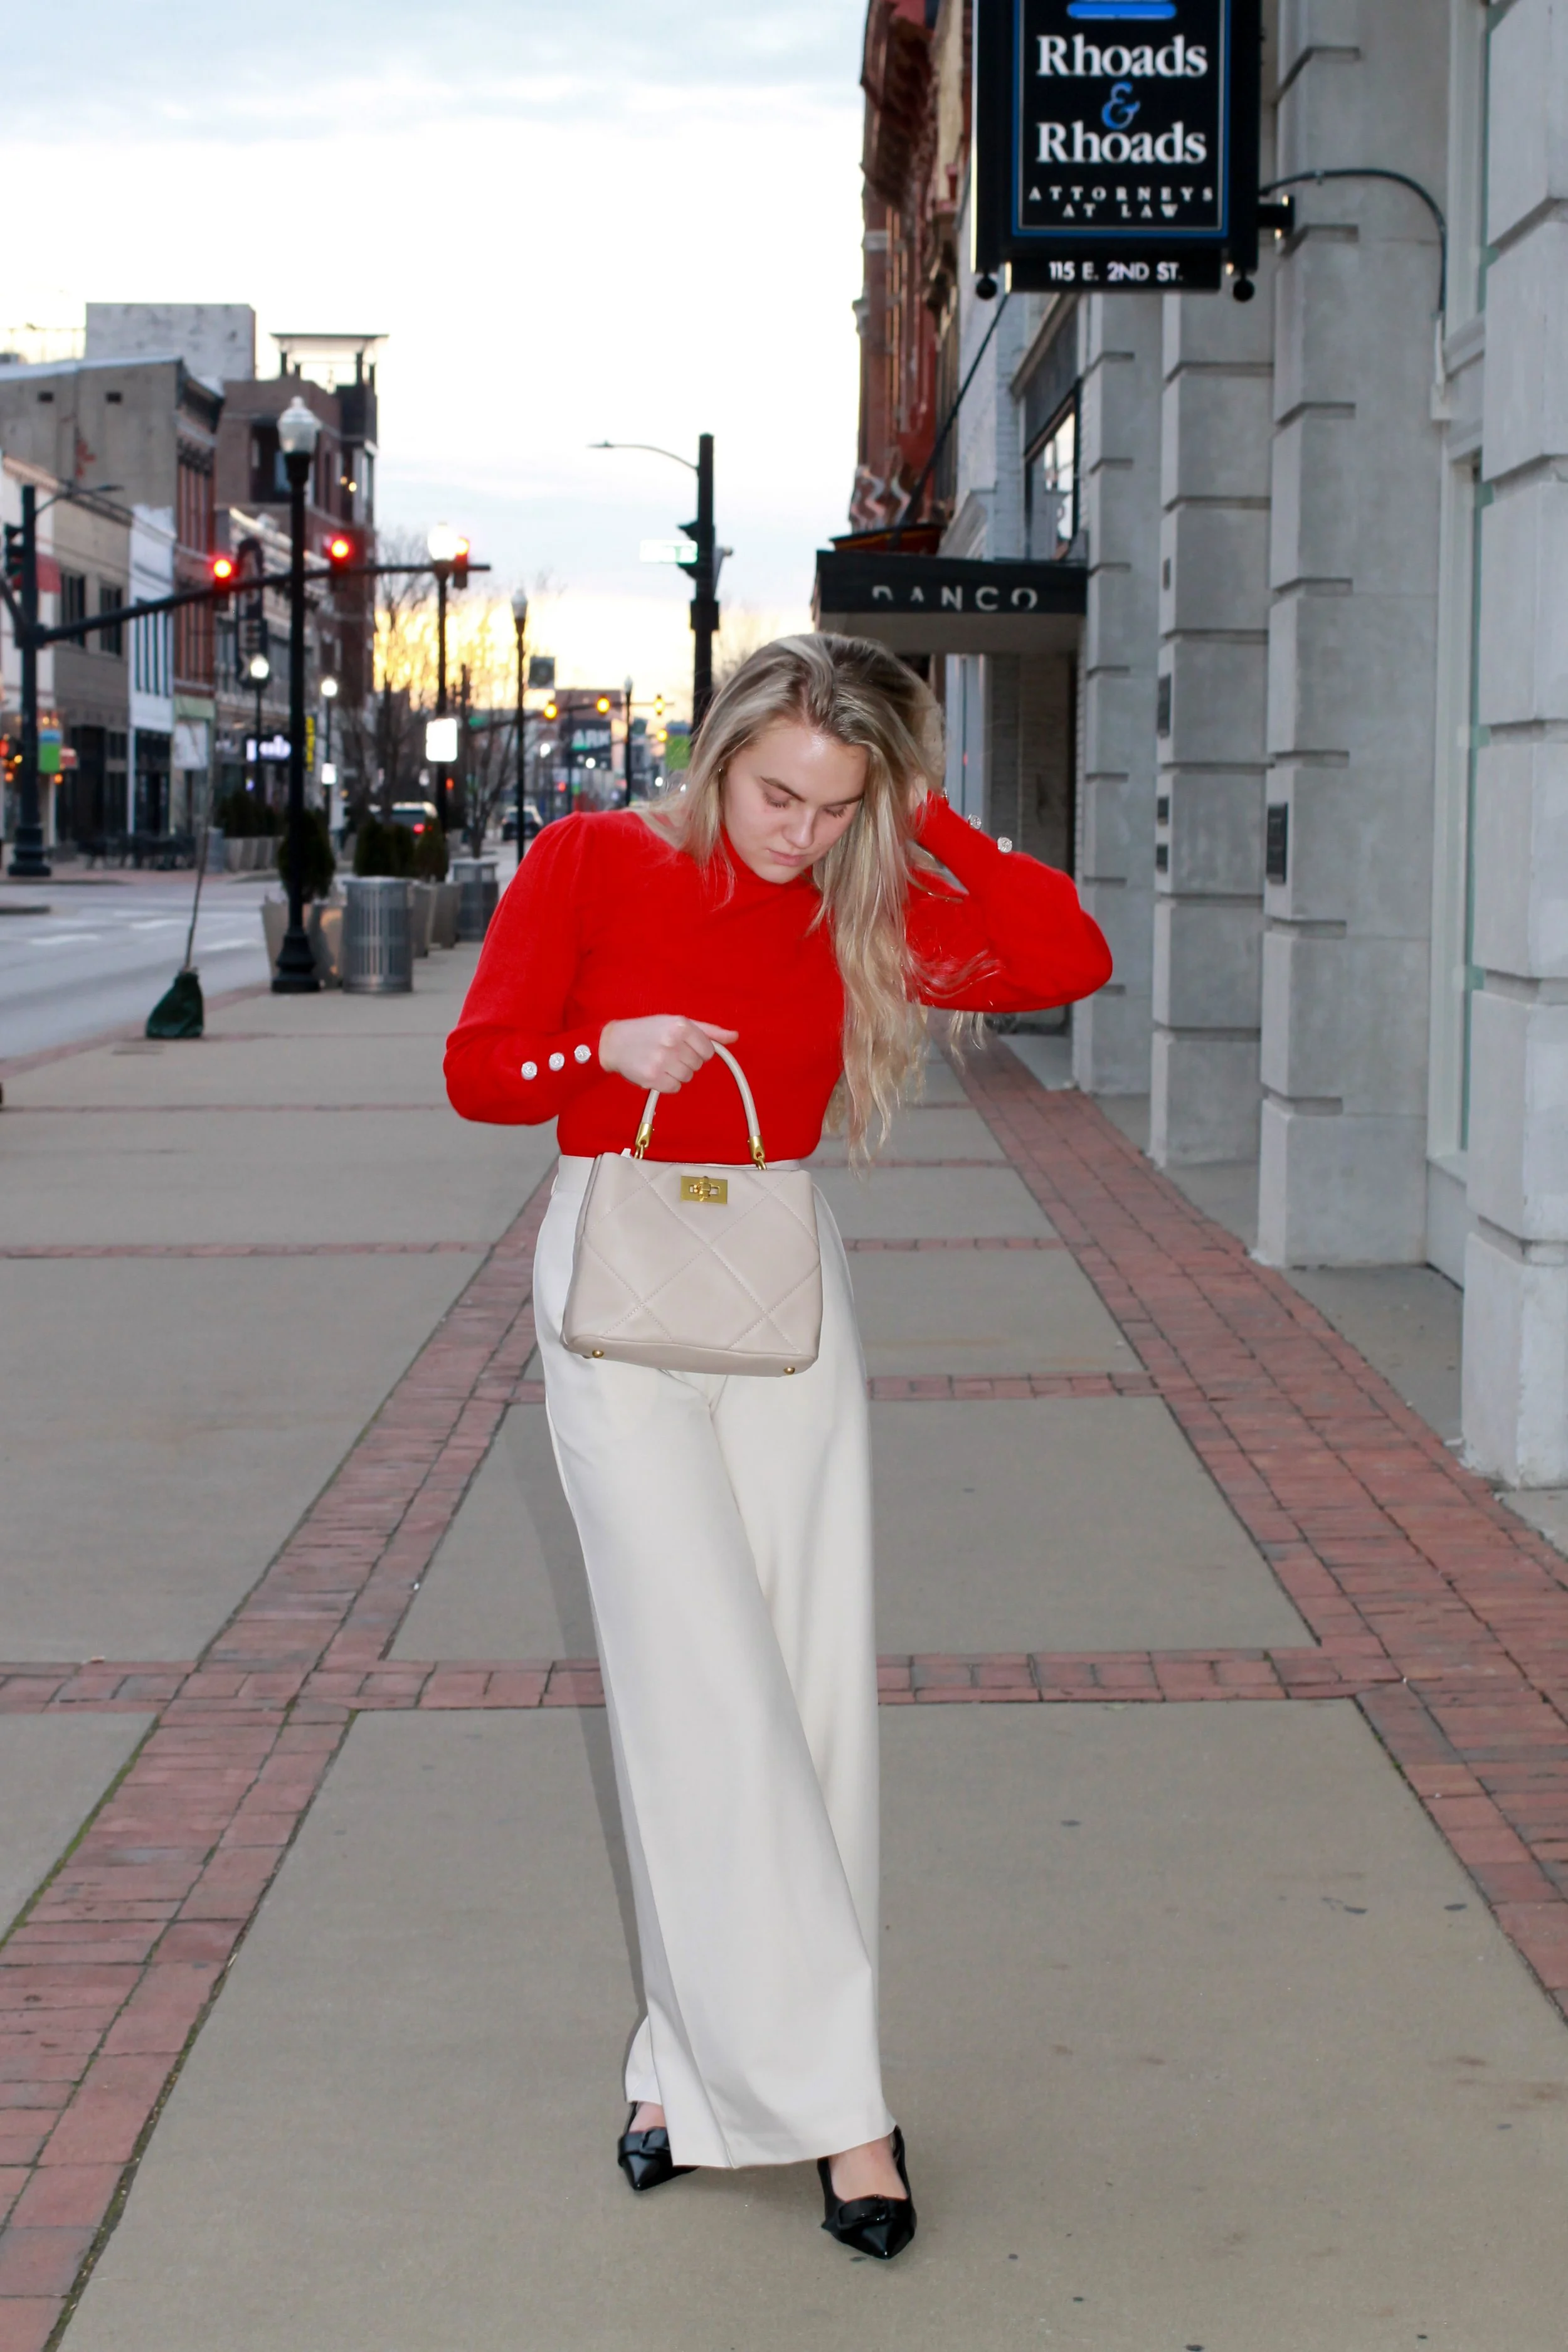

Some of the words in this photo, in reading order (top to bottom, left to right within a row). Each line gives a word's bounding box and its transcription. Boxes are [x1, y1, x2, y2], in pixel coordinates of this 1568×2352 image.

[1037, 33, 1208, 77] Rhoads
[1101, 82, 1140, 129] &
[1037, 120, 1207, 164] Rhoads
[1029, 186, 1213, 201] ATTORNEYS
[1062, 203, 1096, 218] AT
[1121, 204, 1178, 218] LAW
[1049, 262, 1075, 281] 115
[1082, 262, 1099, 281] E.
[1107, 262, 1150, 282] 2ND
[1157, 262, 1183, 281] ST.
